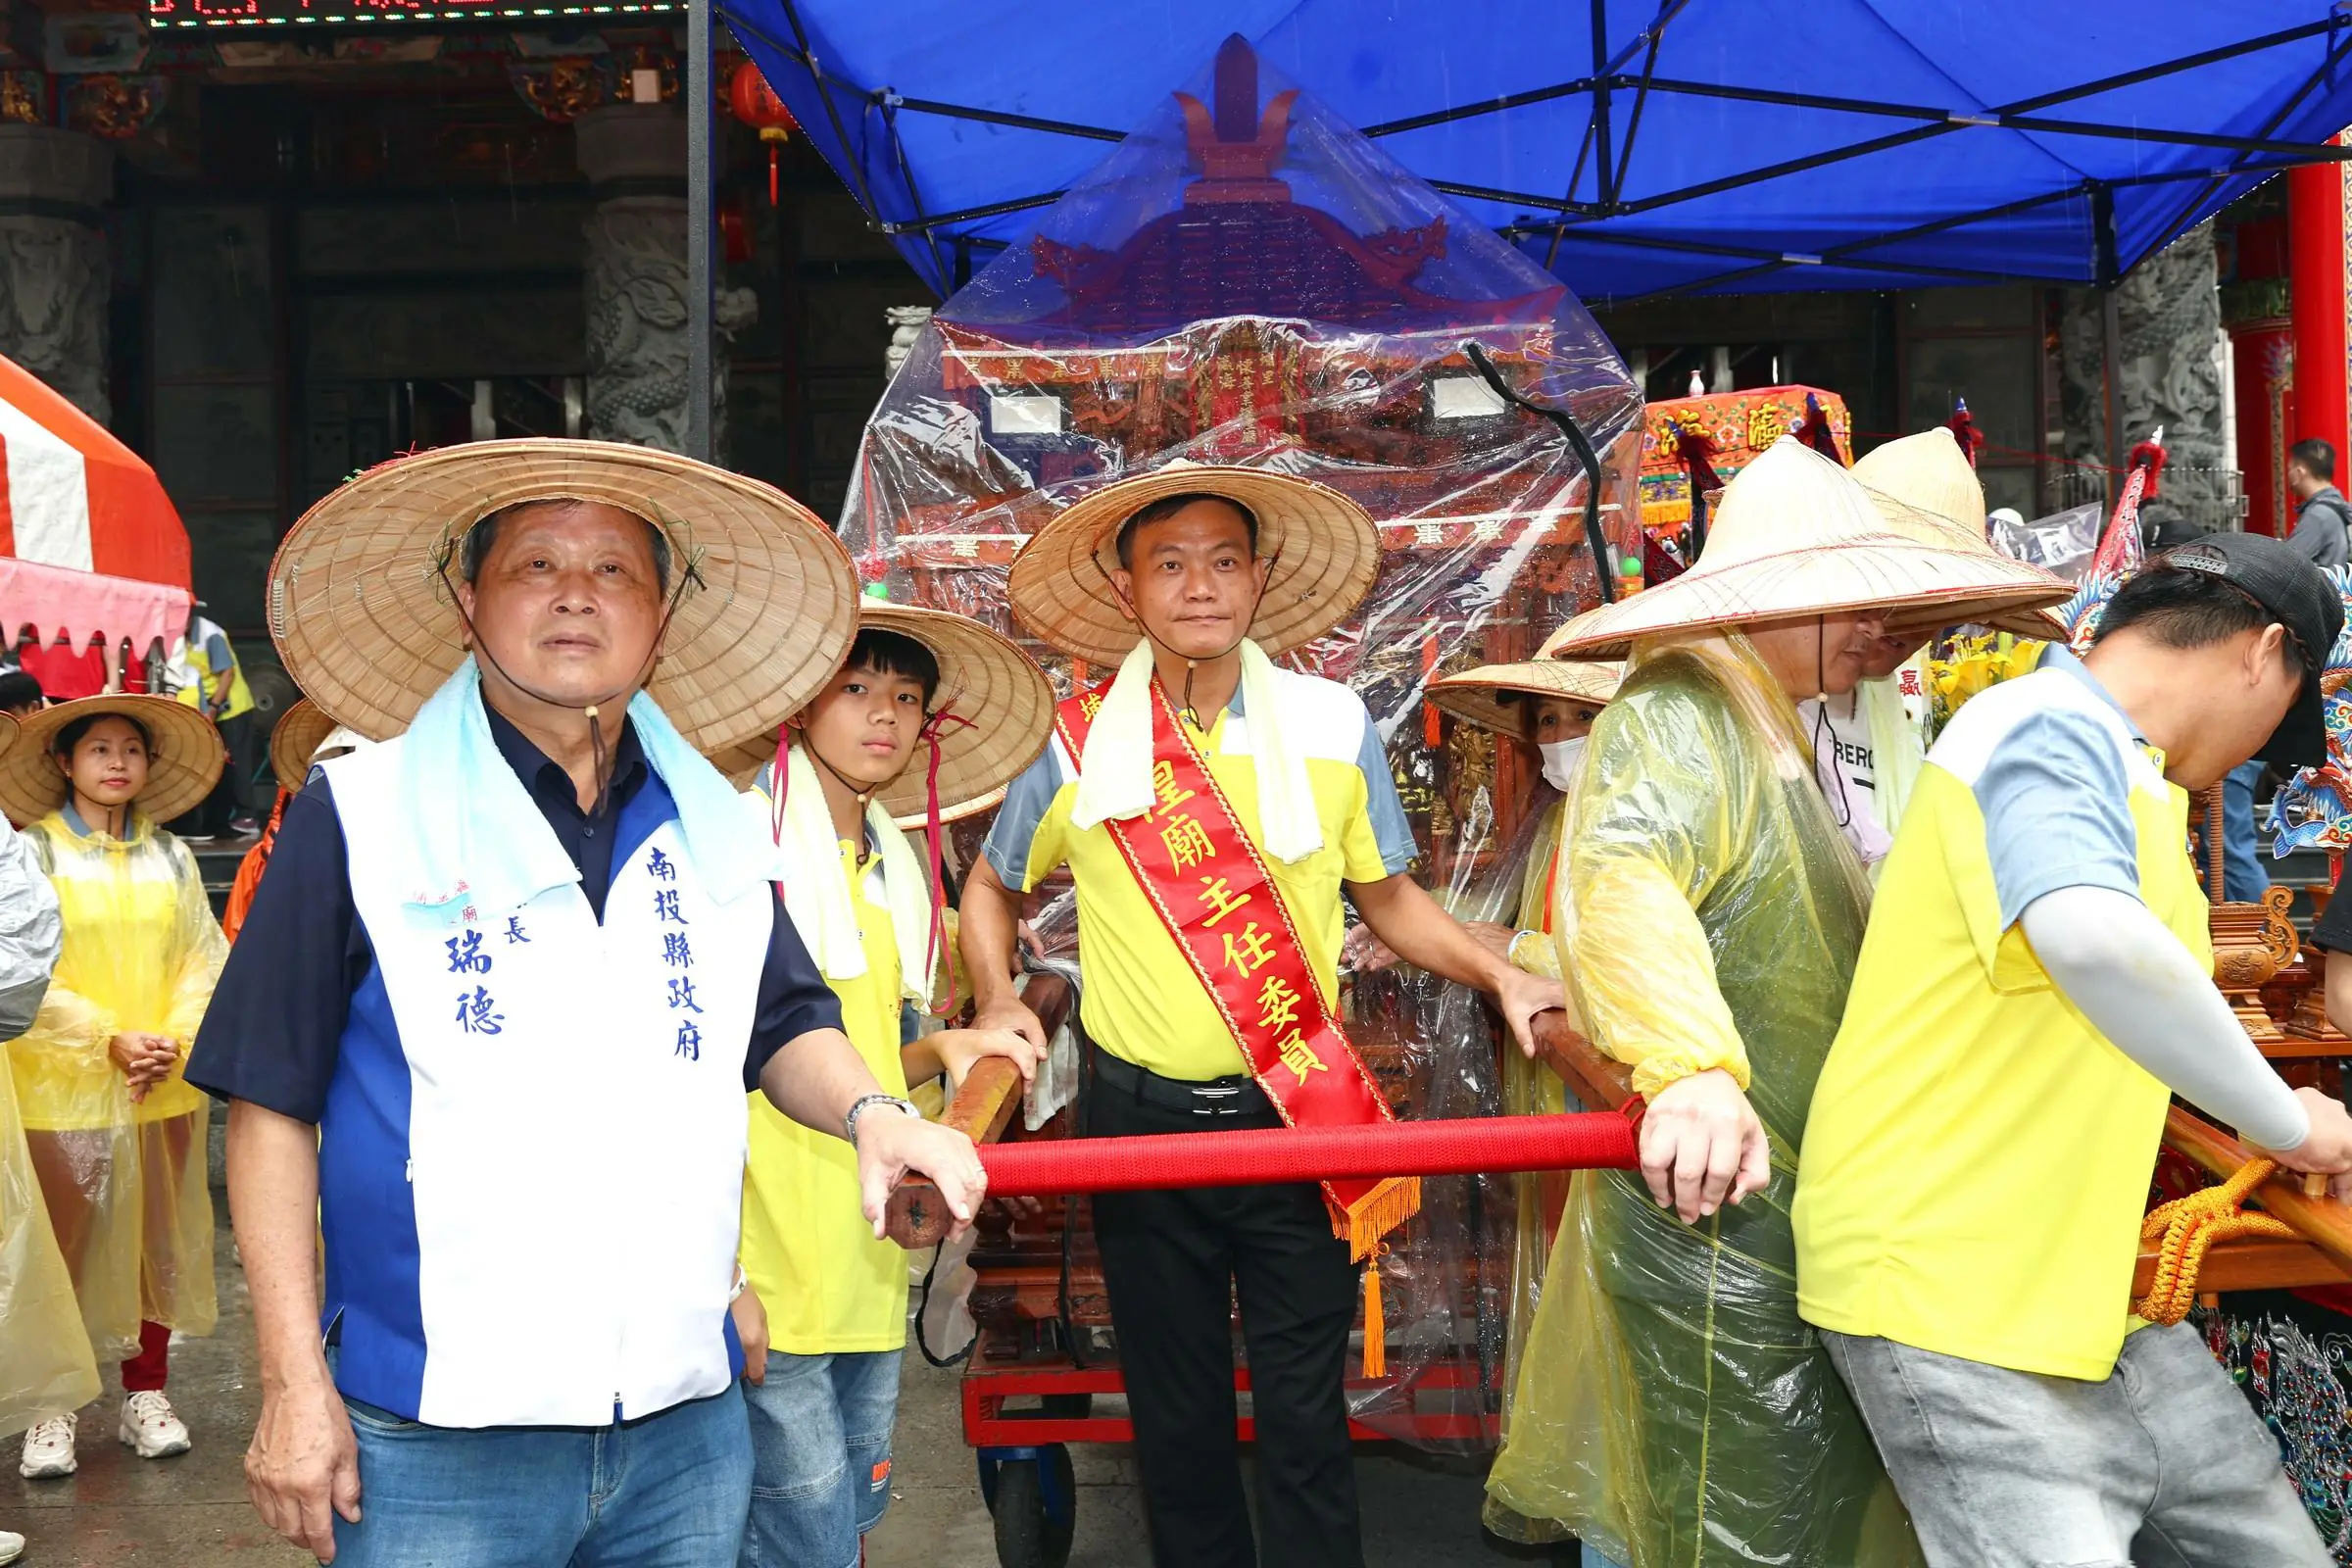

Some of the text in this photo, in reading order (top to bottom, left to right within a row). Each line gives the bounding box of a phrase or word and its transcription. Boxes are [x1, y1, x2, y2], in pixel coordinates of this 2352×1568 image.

[503, 903, 532, 944] 長
[646, 847, 705, 1061] 南投縣政府
[445, 929, 506, 1035] 瑞德
